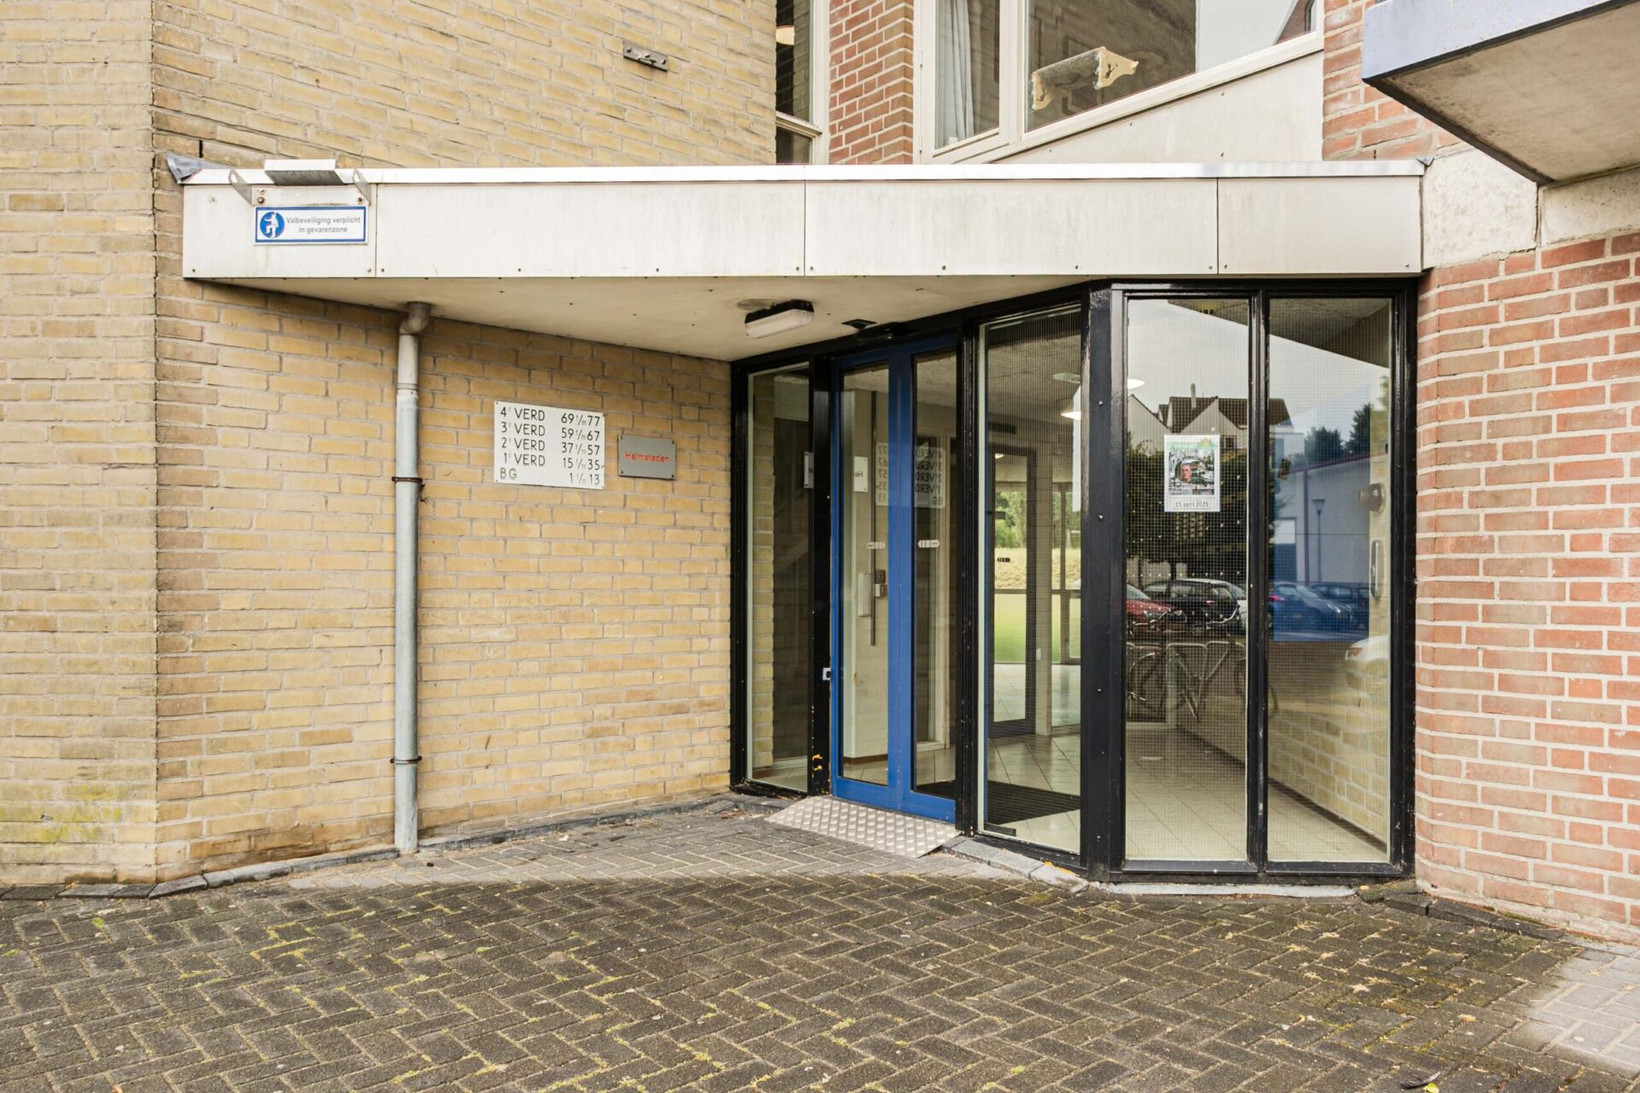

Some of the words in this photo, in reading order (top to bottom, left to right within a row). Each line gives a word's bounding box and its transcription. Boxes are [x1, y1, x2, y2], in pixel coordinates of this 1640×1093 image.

[514, 408, 545, 421] VERD
[514, 423, 546, 436] VERD
[514, 438, 546, 451] VERD
[514, 453, 546, 466] VERD
[500, 467, 517, 480] BG
